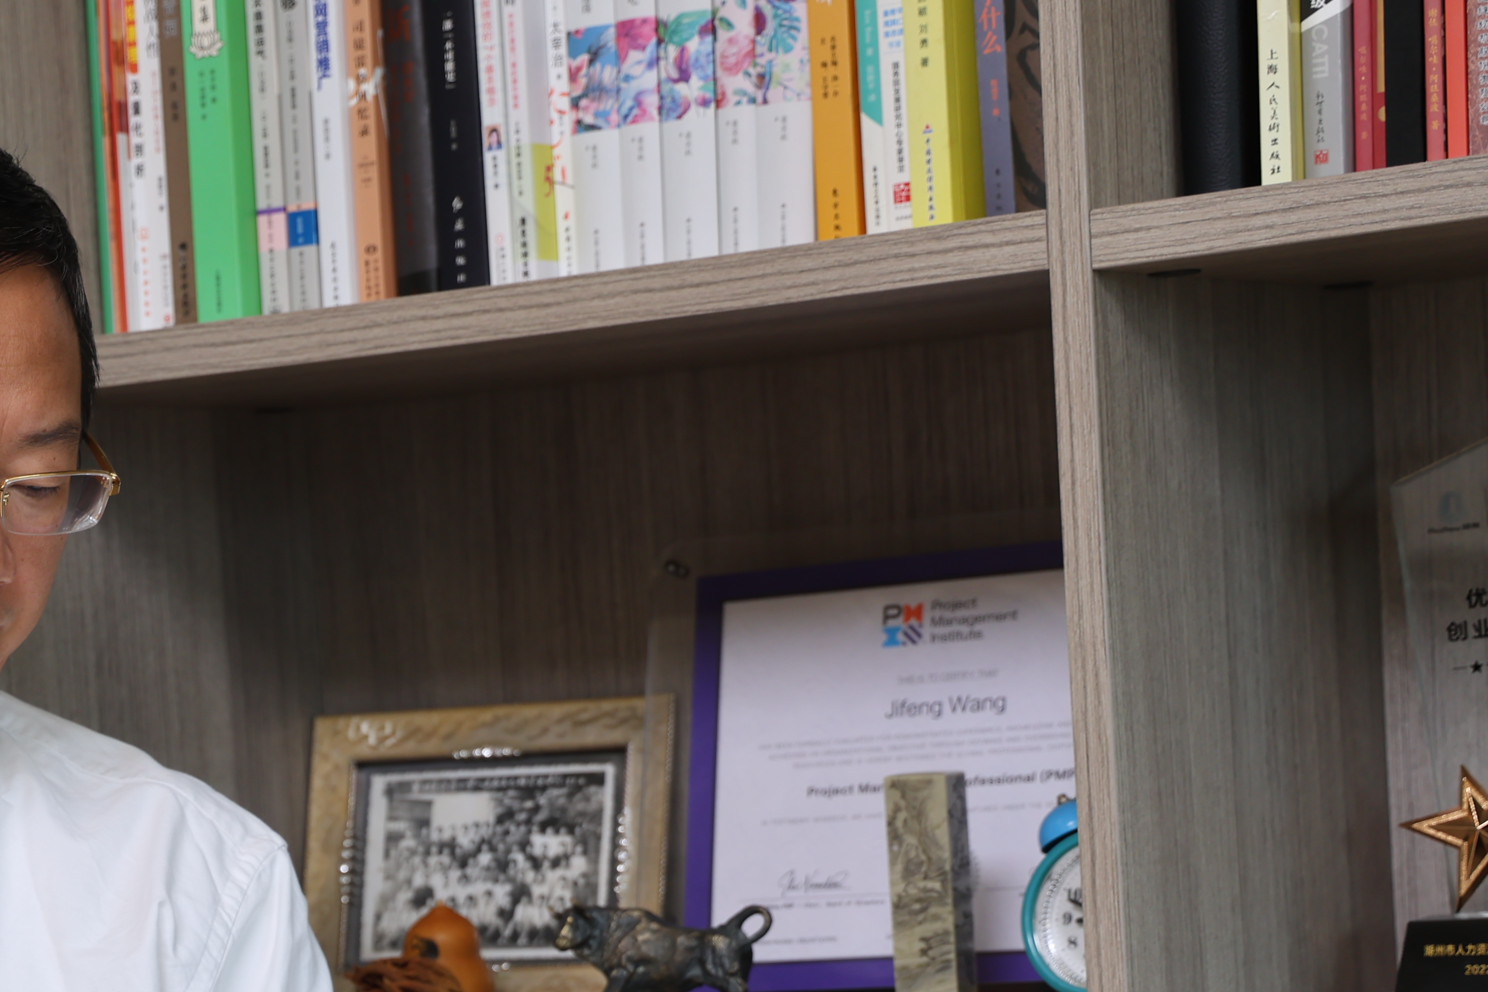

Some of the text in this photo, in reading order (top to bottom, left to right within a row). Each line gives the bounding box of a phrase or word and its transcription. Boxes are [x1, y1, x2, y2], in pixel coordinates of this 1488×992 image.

[979, 0, 1003, 54] 什么
[1312, 24, 1329, 79] CATTI
[930, 599, 977, 612] Project
[1466, 587, 1488, 609] 优
[930, 610, 1018, 628] Management
[930, 630, 983, 643] Institute
[884, 693, 1007, 719] Jifeng Wang
[807, 785, 854, 798] Project
[1464, 964, 1488, 976] 202
